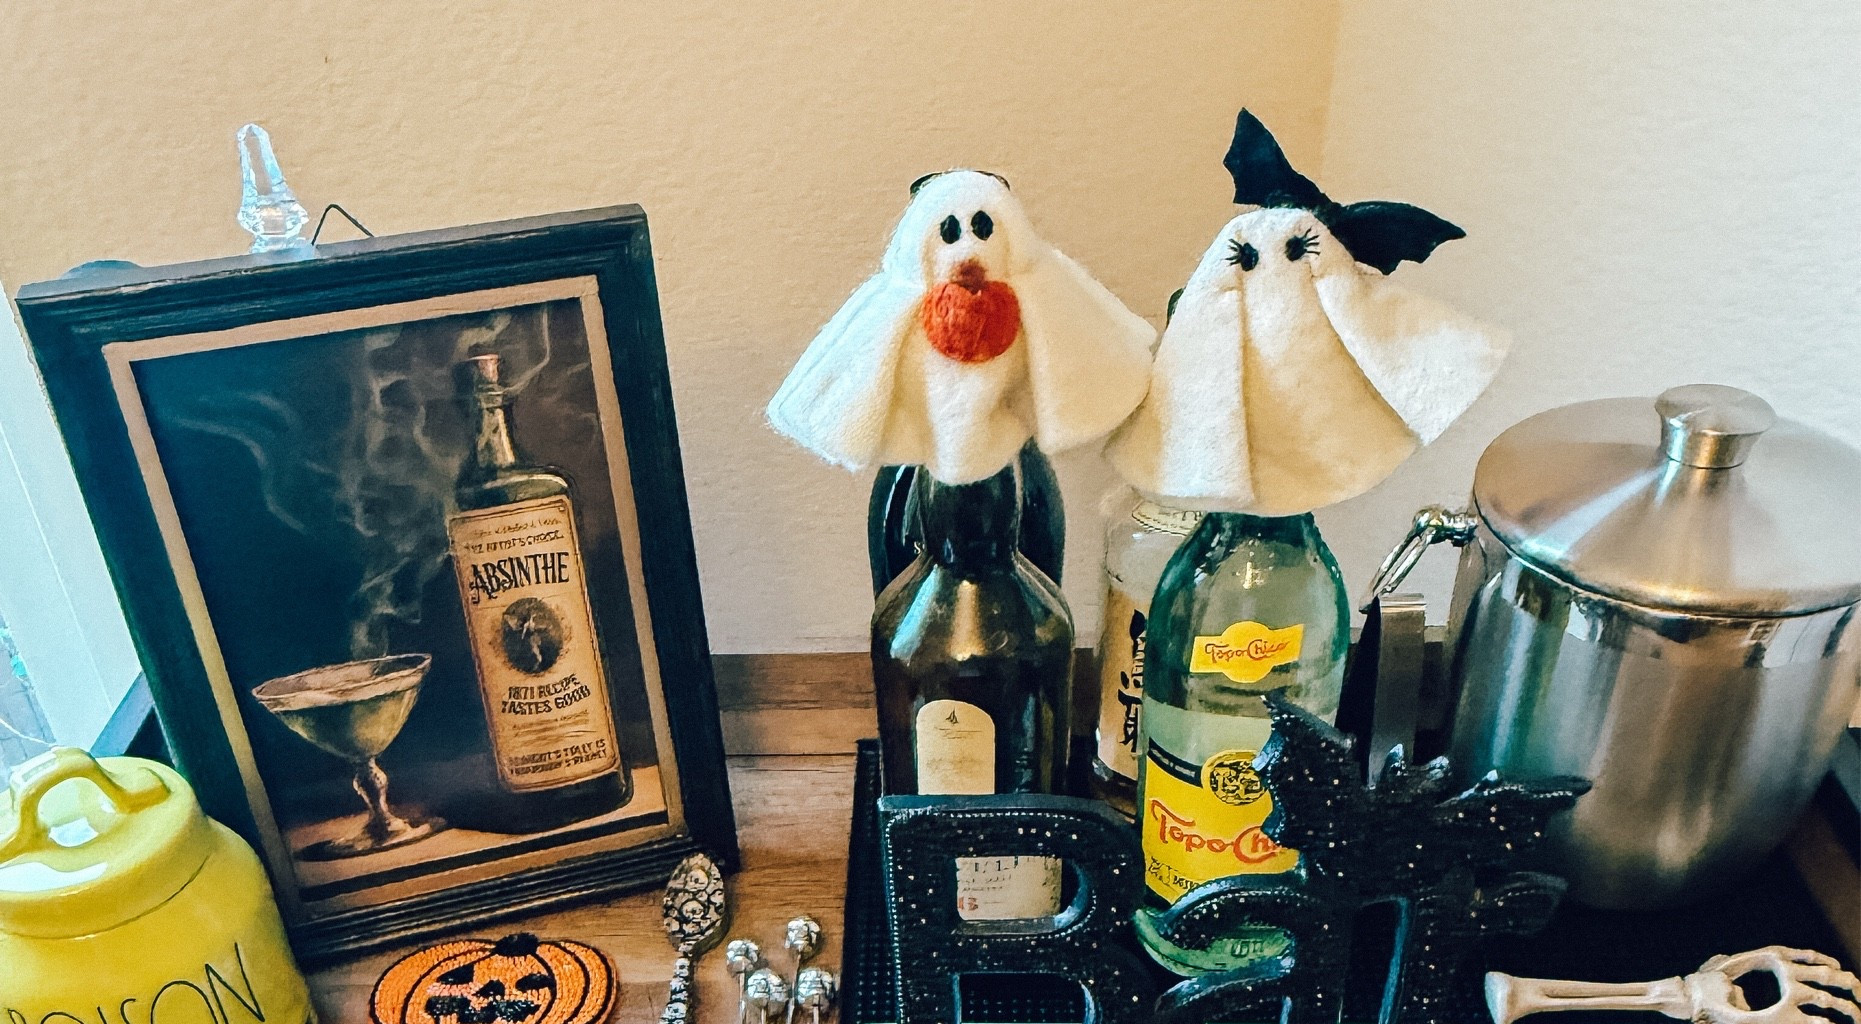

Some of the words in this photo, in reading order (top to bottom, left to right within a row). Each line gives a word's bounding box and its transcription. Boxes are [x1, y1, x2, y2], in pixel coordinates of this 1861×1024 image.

[469, 551, 570, 604] ABSINTHE
[1205, 643, 1247, 664] Topo
[501, 699, 553, 716] TASTES
[1150, 799, 1234, 852] Topo
